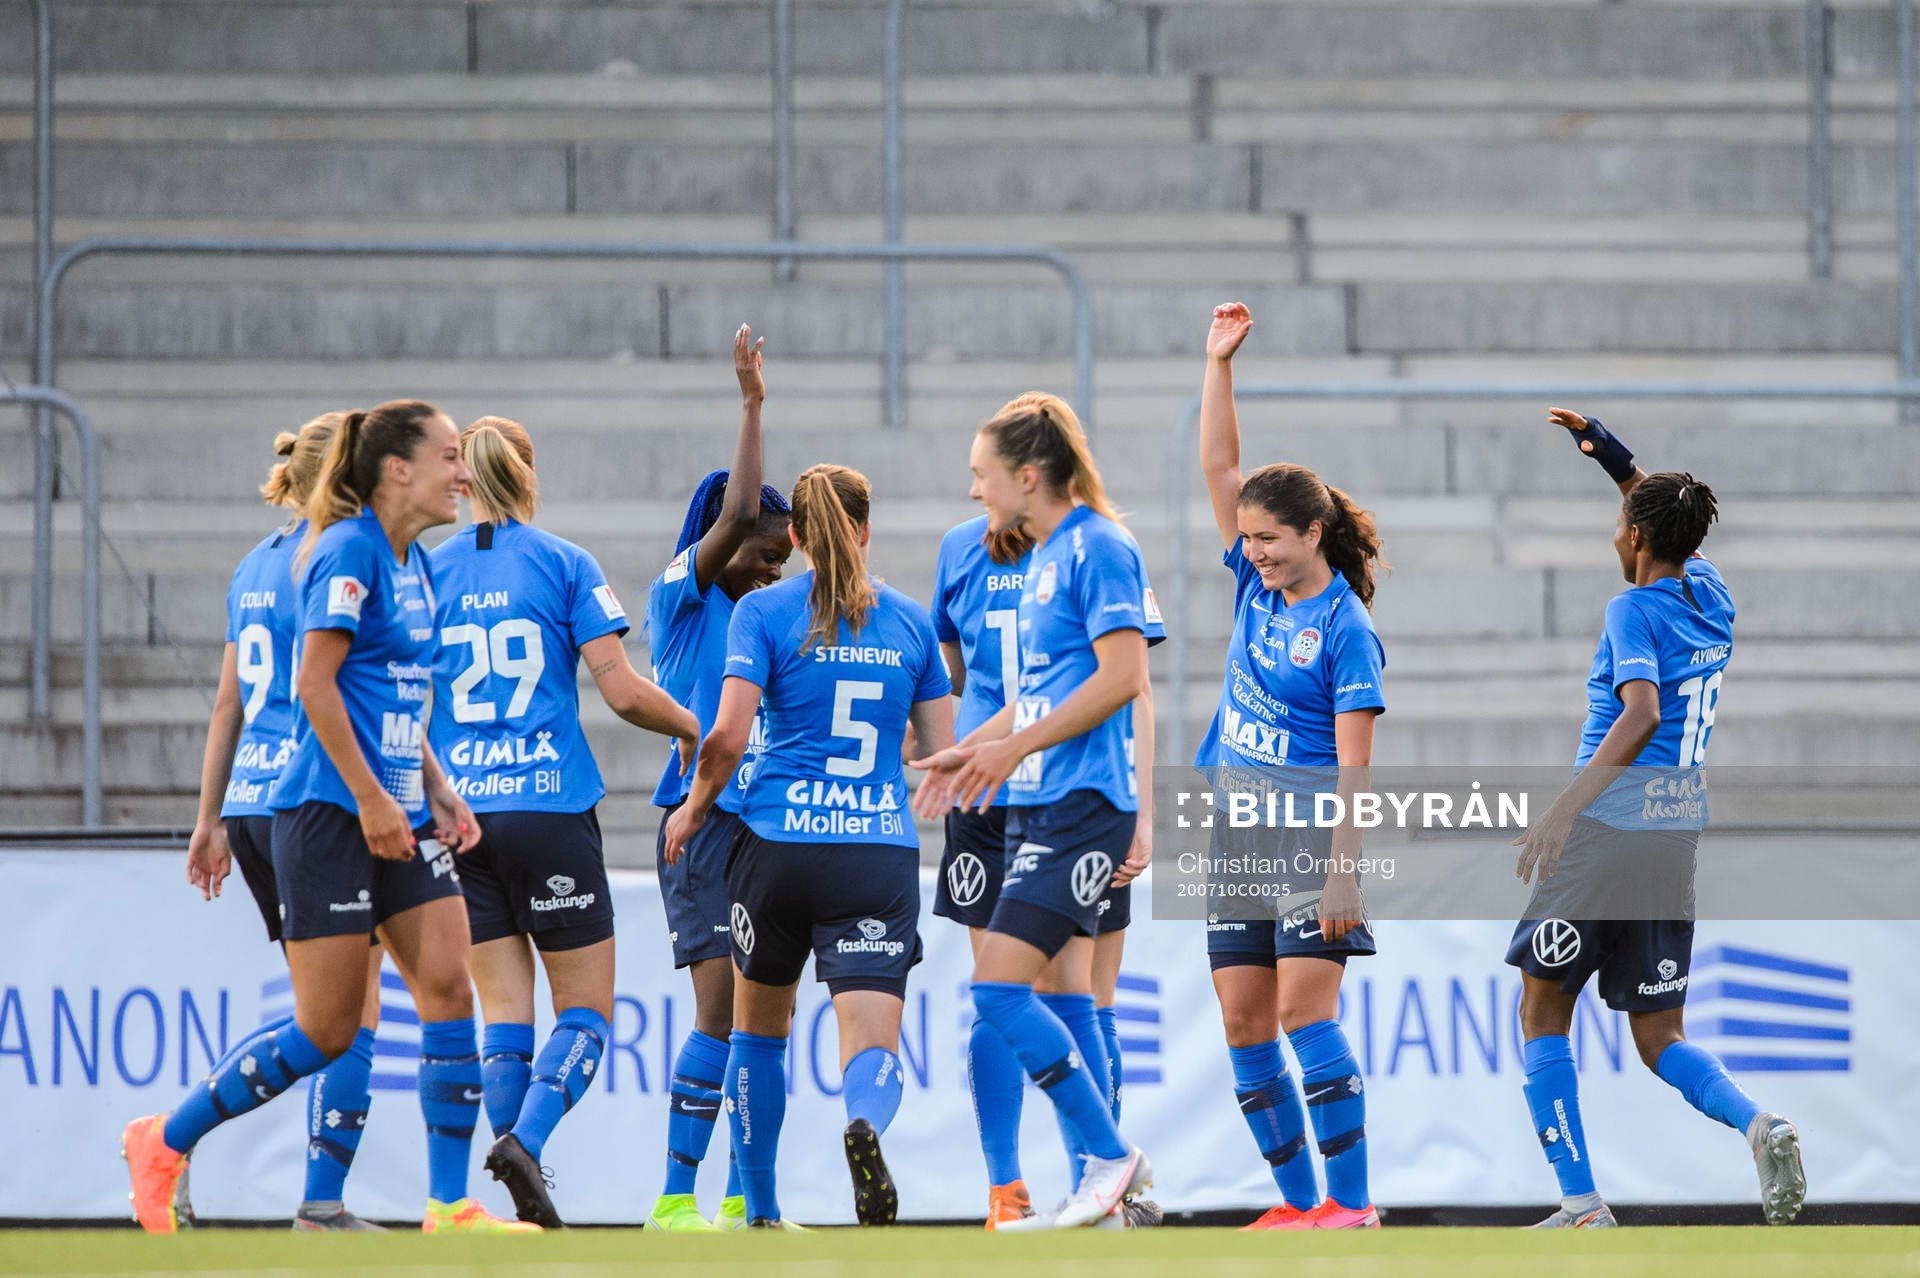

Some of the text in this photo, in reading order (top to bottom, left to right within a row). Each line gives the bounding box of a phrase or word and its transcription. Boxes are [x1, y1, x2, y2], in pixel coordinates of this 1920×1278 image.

[240, 591, 276, 608] COLLIN
[461, 591, 508, 610] PLAN
[815, 646, 902, 667] STENEVIK
[1619, 657, 1656, 667] MAGNOLIA
[1690, 643, 1731, 665] AYINDE
[441, 618, 545, 723] 29
[1335, 682, 1373, 694] MAGNOLIA
[826, 680, 883, 778] 5
[1223, 704, 1289, 757] MAXI
[450, 730, 560, 767] GIMLÄ
[535, 770, 560, 794] Bil
[786, 780, 899, 812] GIMLÄ
[880, 812, 904, 836] Bil
[530, 893, 594, 911] faskunge
[837, 938, 904, 956] faskunge
[737, 1066, 753, 1145] MaxFASTIGHETER
